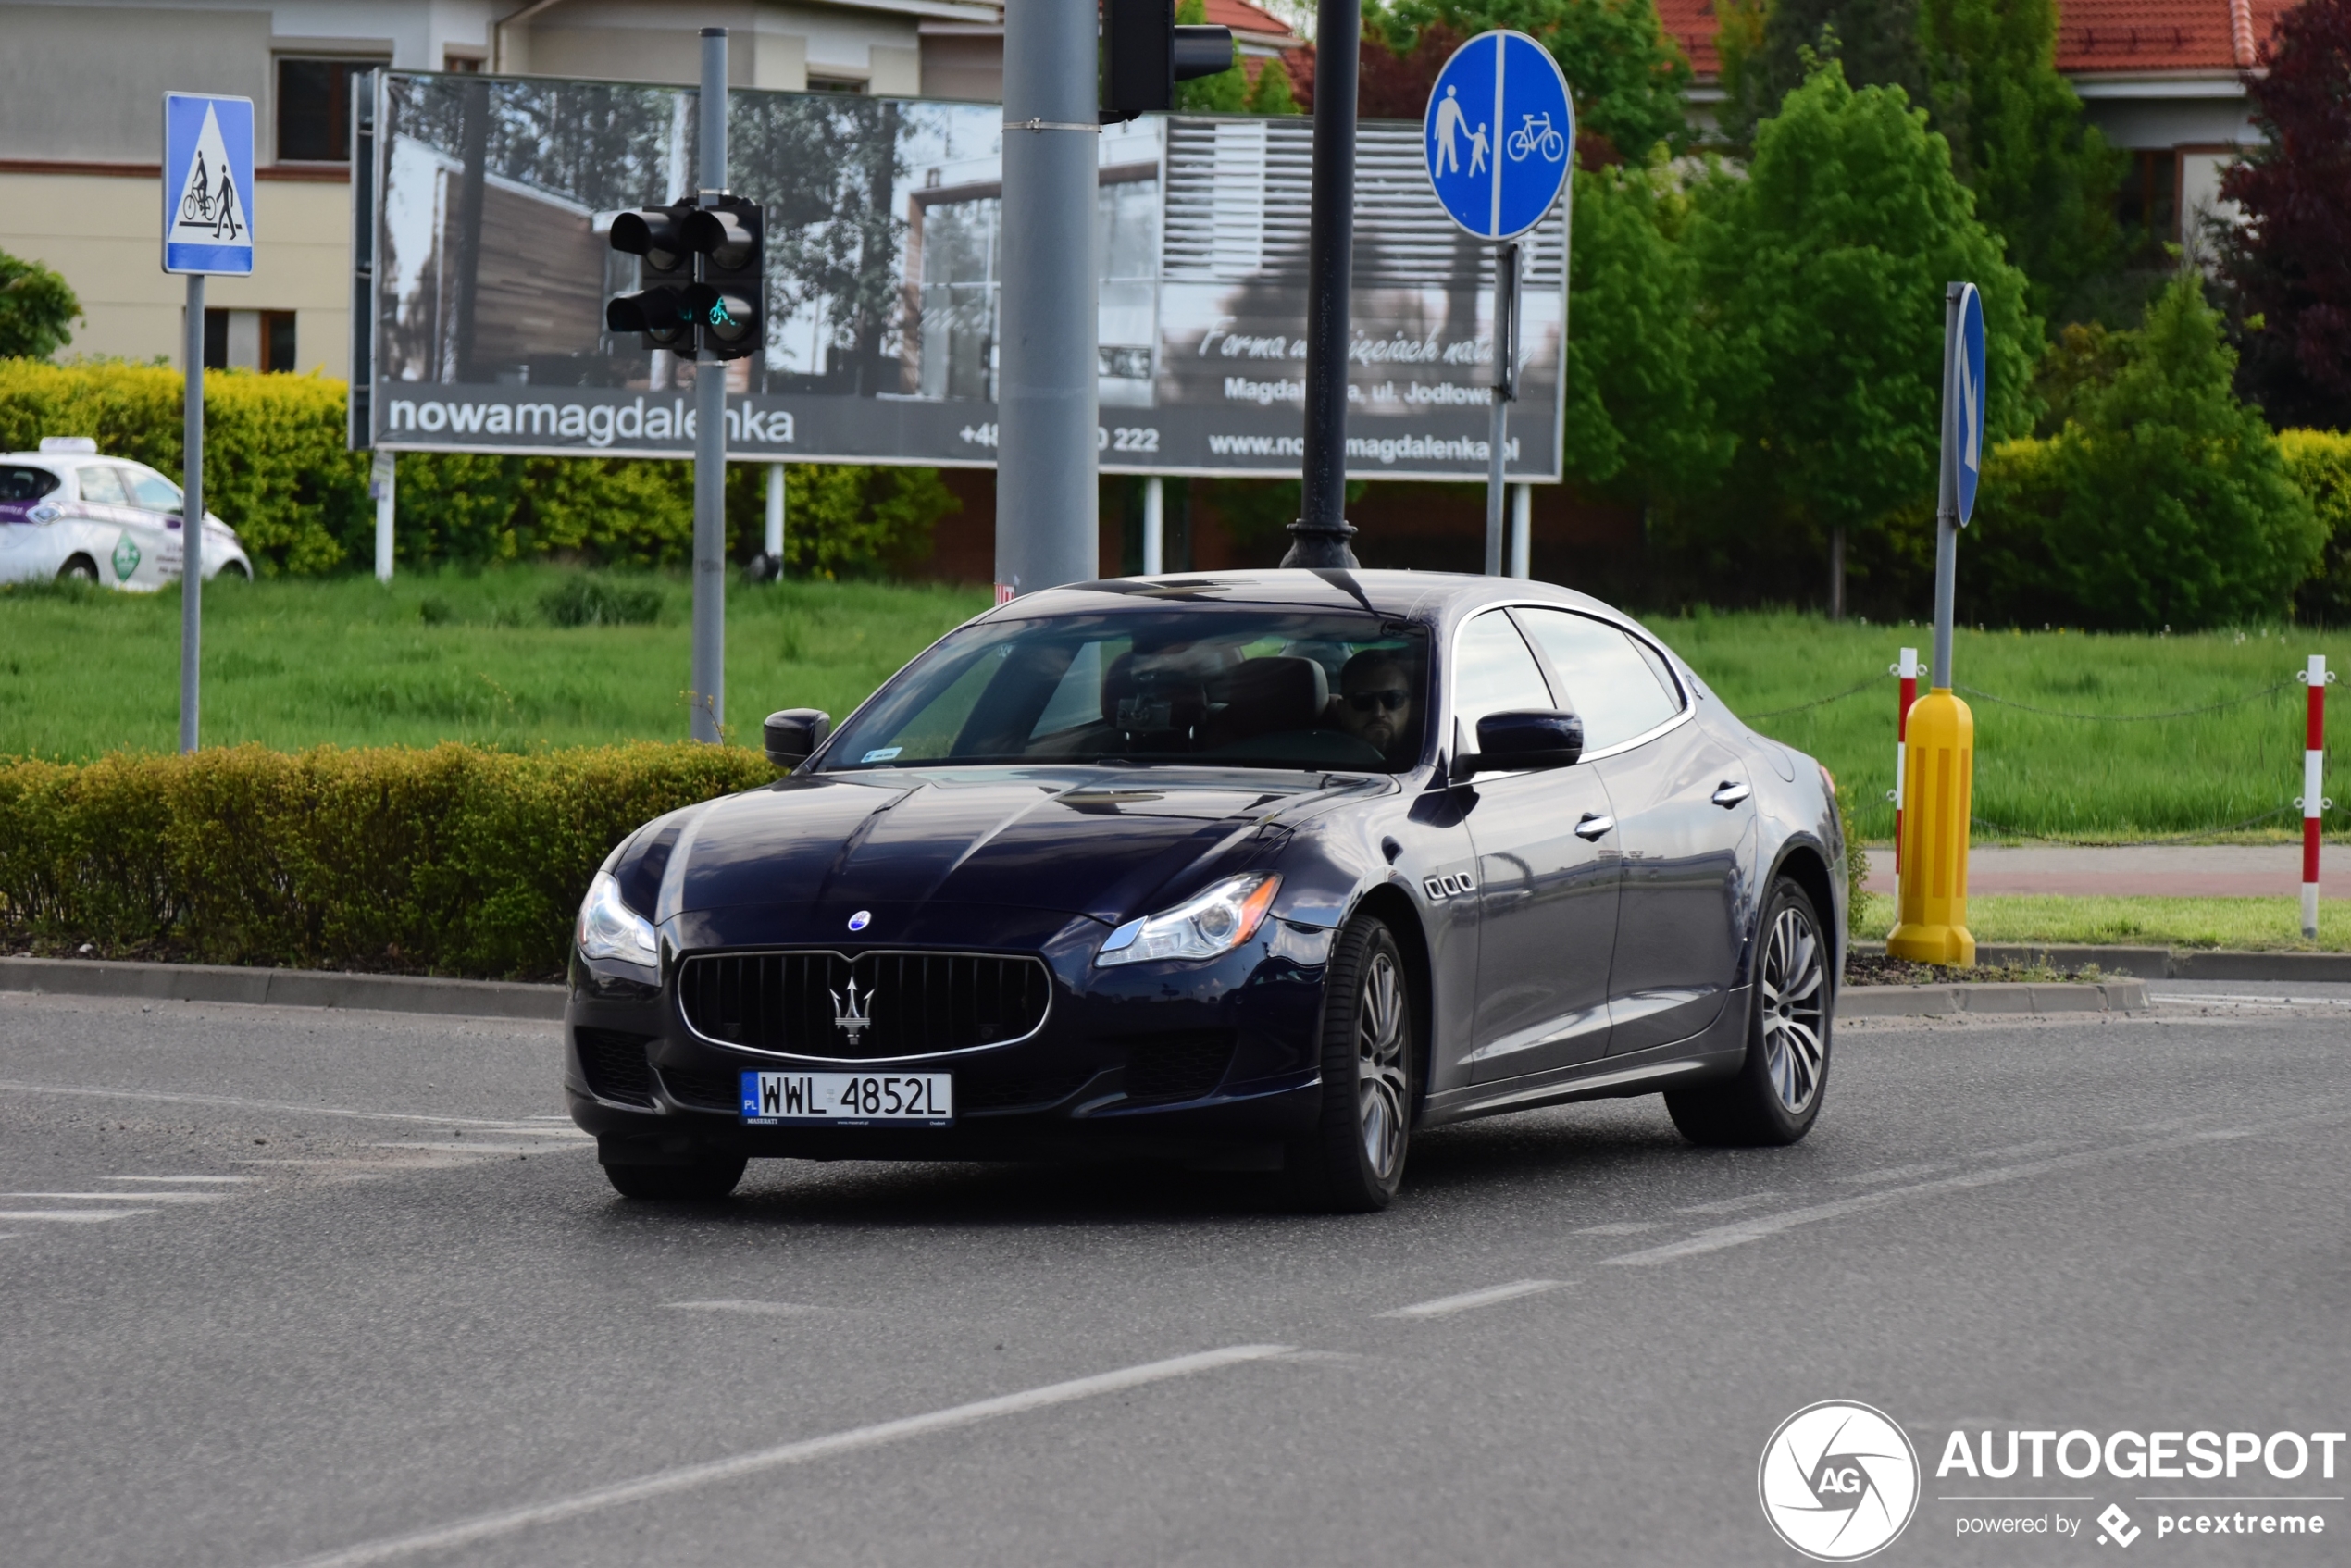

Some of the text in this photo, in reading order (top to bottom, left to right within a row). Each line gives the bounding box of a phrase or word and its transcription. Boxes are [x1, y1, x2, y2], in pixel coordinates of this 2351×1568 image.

[1198, 316, 1287, 360] Forma
[1224, 376, 1368, 405] Magdala,
[1371, 380, 1399, 404] ul.
[1113, 426, 1160, 453] 222
[743, 1076, 947, 1115] PL WWL 4852L
